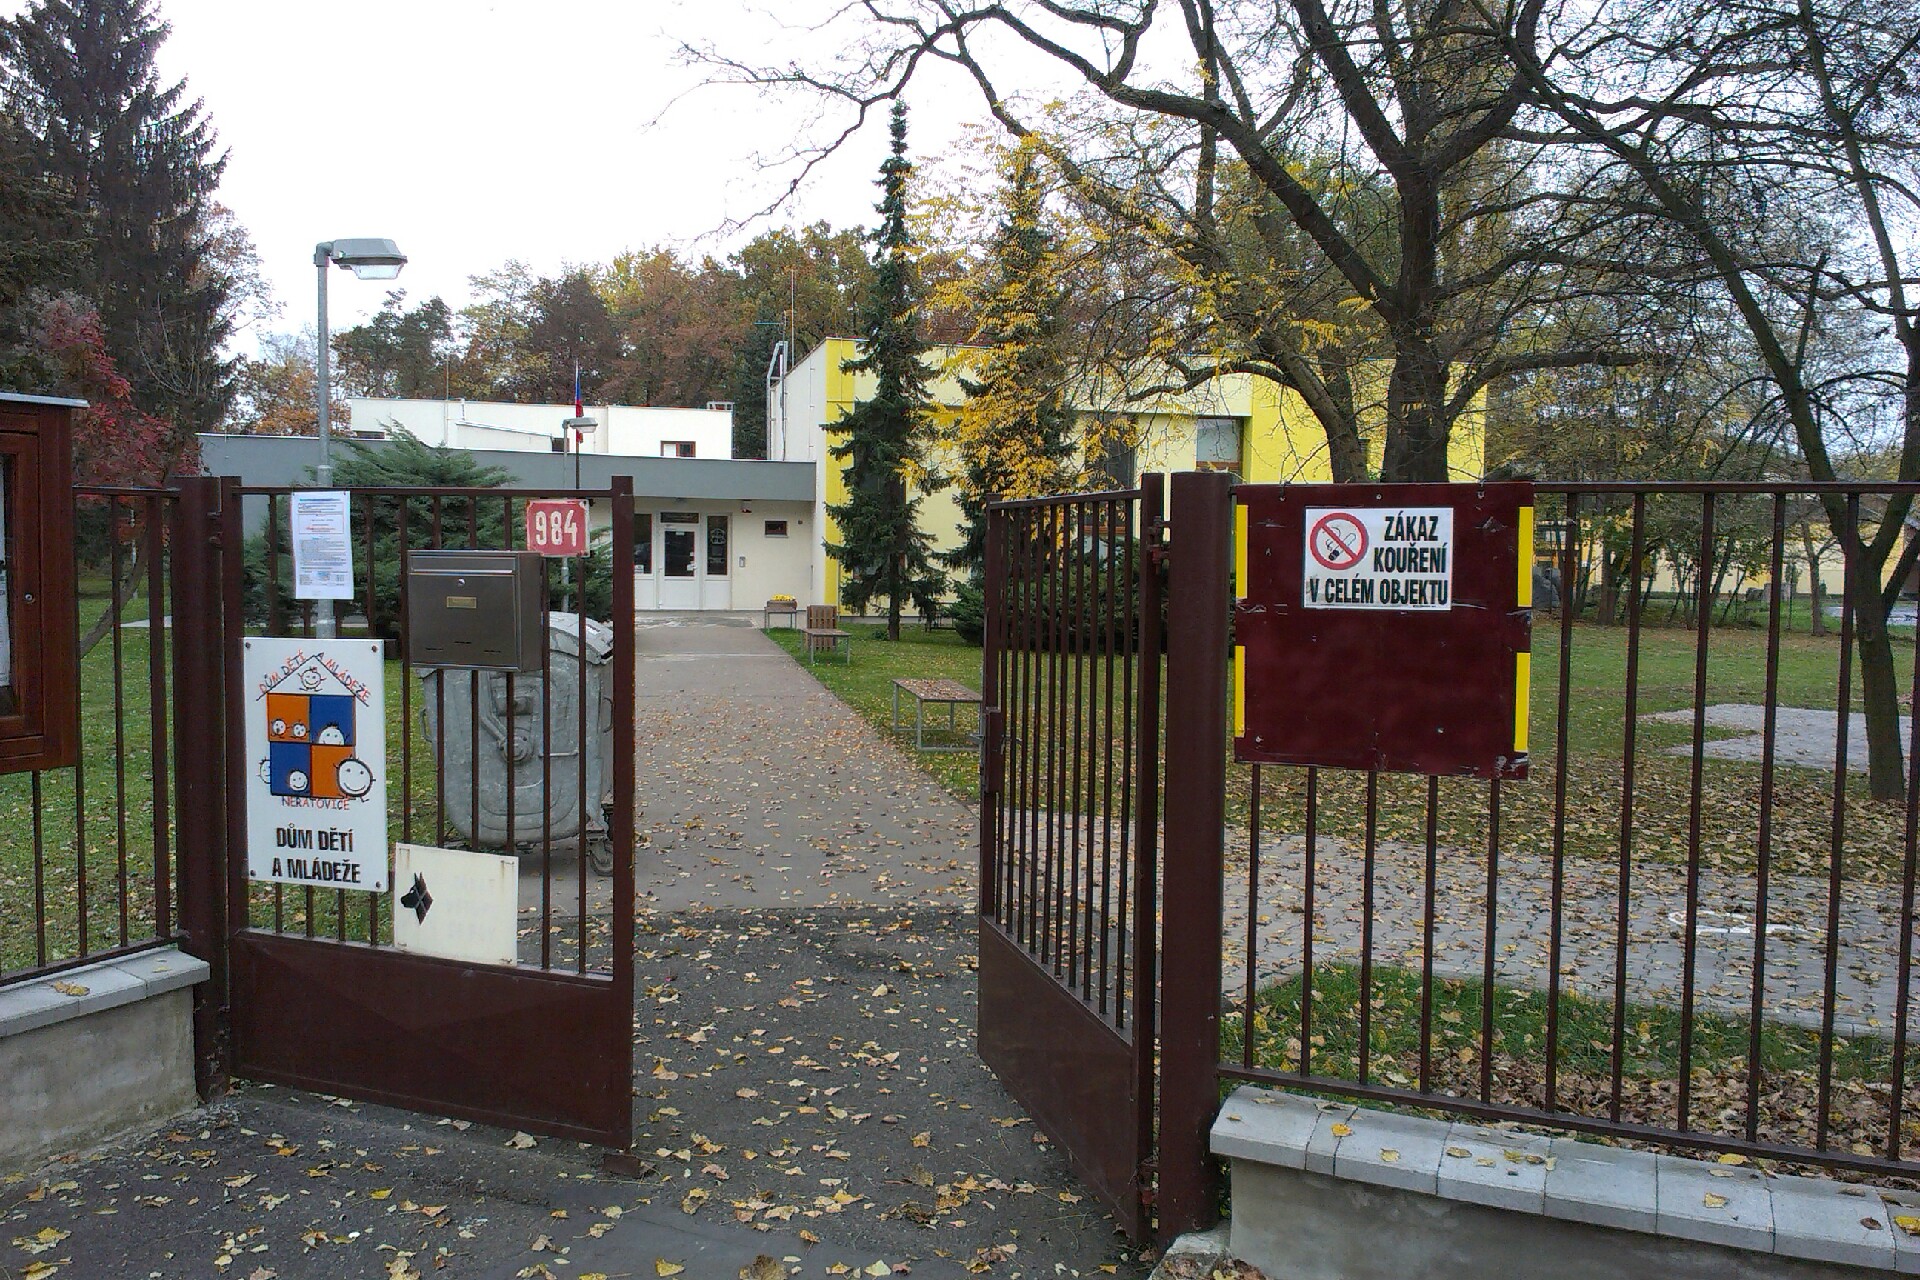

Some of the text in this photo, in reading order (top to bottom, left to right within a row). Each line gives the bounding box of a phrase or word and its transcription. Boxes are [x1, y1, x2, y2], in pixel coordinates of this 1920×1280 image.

[535, 509, 578, 547] 984
[1384, 510, 1439, 541] ZÁKAZ
[1373, 542, 1448, 573] KOUŘENÍ
[1308, 573, 1448, 605] V CELÉM OBJEKTU
[259, 672, 281, 693] DŮM
[281, 795, 350, 811] NERATOVICE
[276, 822, 354, 852] DŮM DĚTÍ
[272, 857, 361, 884] A MLÁDEŽE
